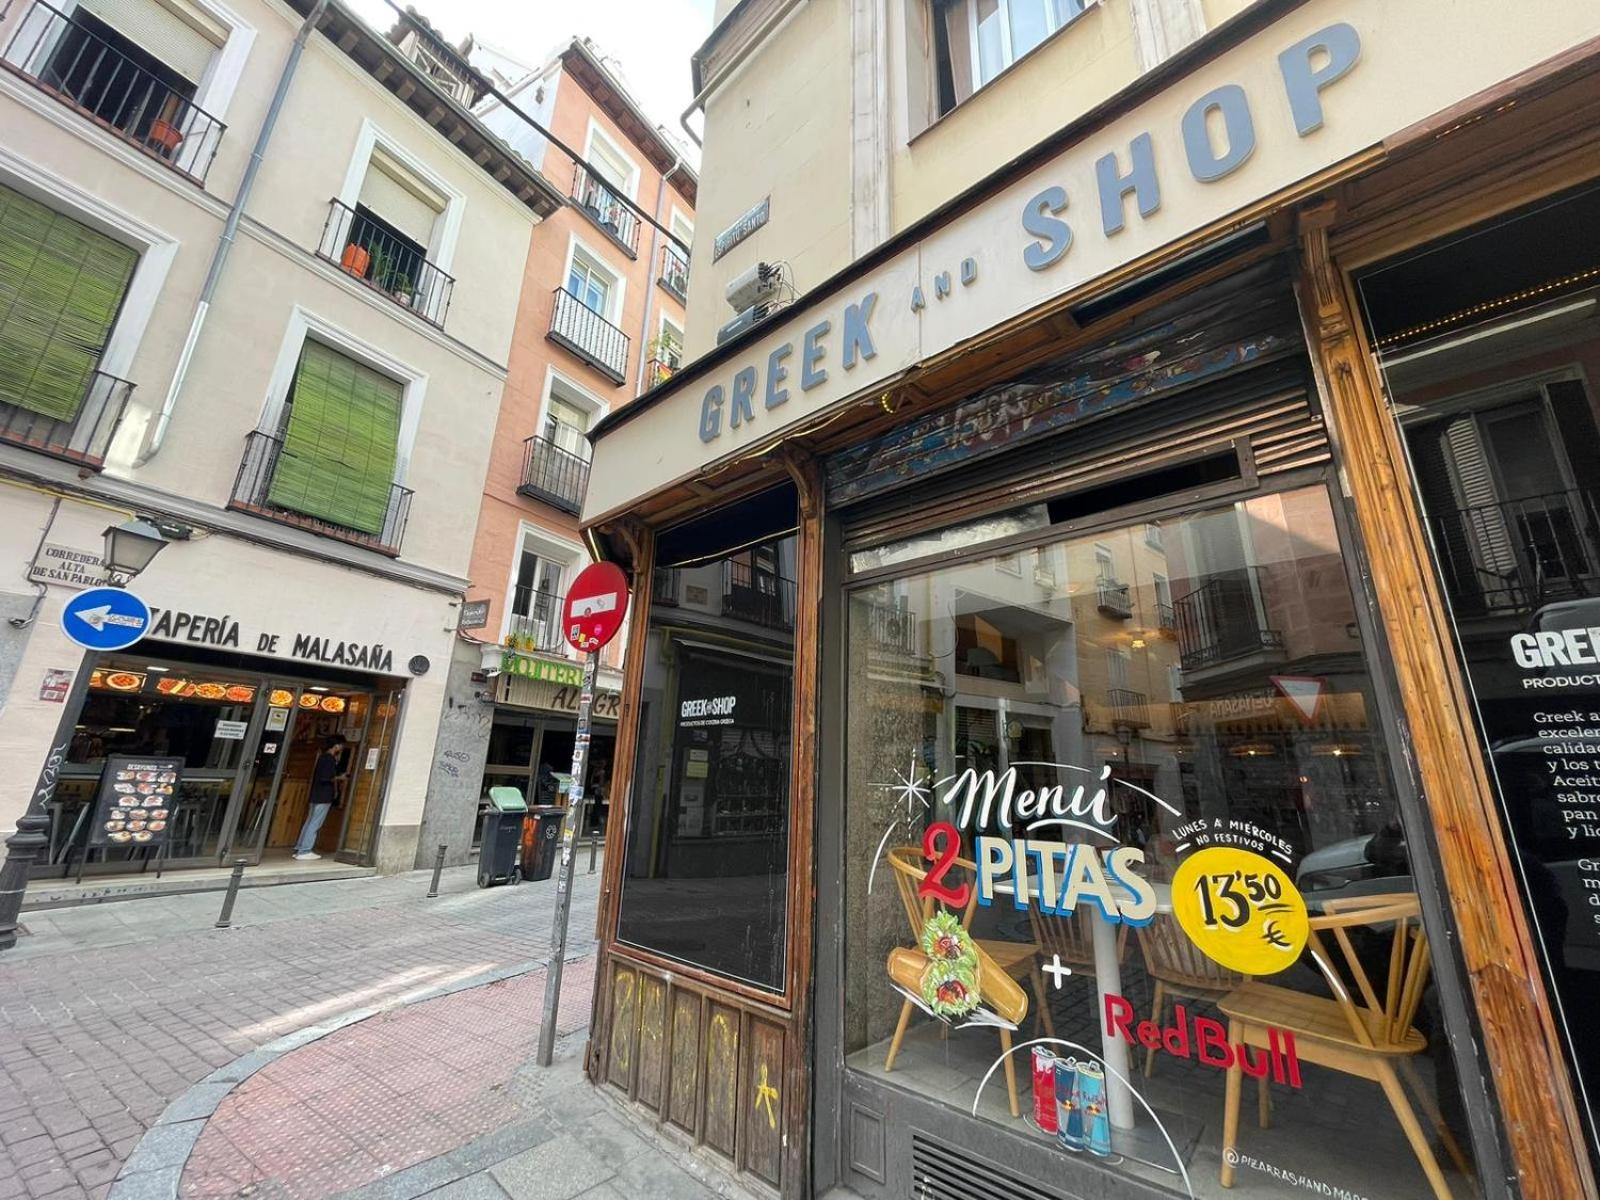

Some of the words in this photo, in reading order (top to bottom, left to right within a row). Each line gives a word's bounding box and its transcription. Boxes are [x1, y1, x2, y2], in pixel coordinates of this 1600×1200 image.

[698, 292, 878, 443] GREEK
[910, 257, 977, 313] AND
[1022, 22, 1361, 271] SHOP
[45, 547, 107, 567] CORREDERA
[58, 561, 85, 574] ALTA
[32, 566, 46, 577] DE
[47, 569, 69, 581] SAN
[70, 573, 104, 587] PABLO
[257, 633, 280, 653] DE
[292, 633, 393, 672] MALASAÑA
[681, 699, 707, 718] GREEK
[711, 696, 736, 715] SHOP
[1533, 710, 1585, 723] Greek
[1547, 761, 1557, 773] y
[1561, 758, 1589, 770] los
[944, 765, 1118, 829] Menú
[1561, 810, 1598, 823] pan
[1172, 819, 1208, 840] LUNES
[1214, 818, 1222, 828] A
[1229, 820, 1293, 855] MIÉRCOLES
[1195, 834, 1210, 846] NO
[1214, 833, 1264, 851] FESTIVOS
[1567, 826, 1577, 839] y
[919, 821, 970, 909] 2
[976, 835, 1157, 928] PITAS
[1261, 920, 1292, 948] €
